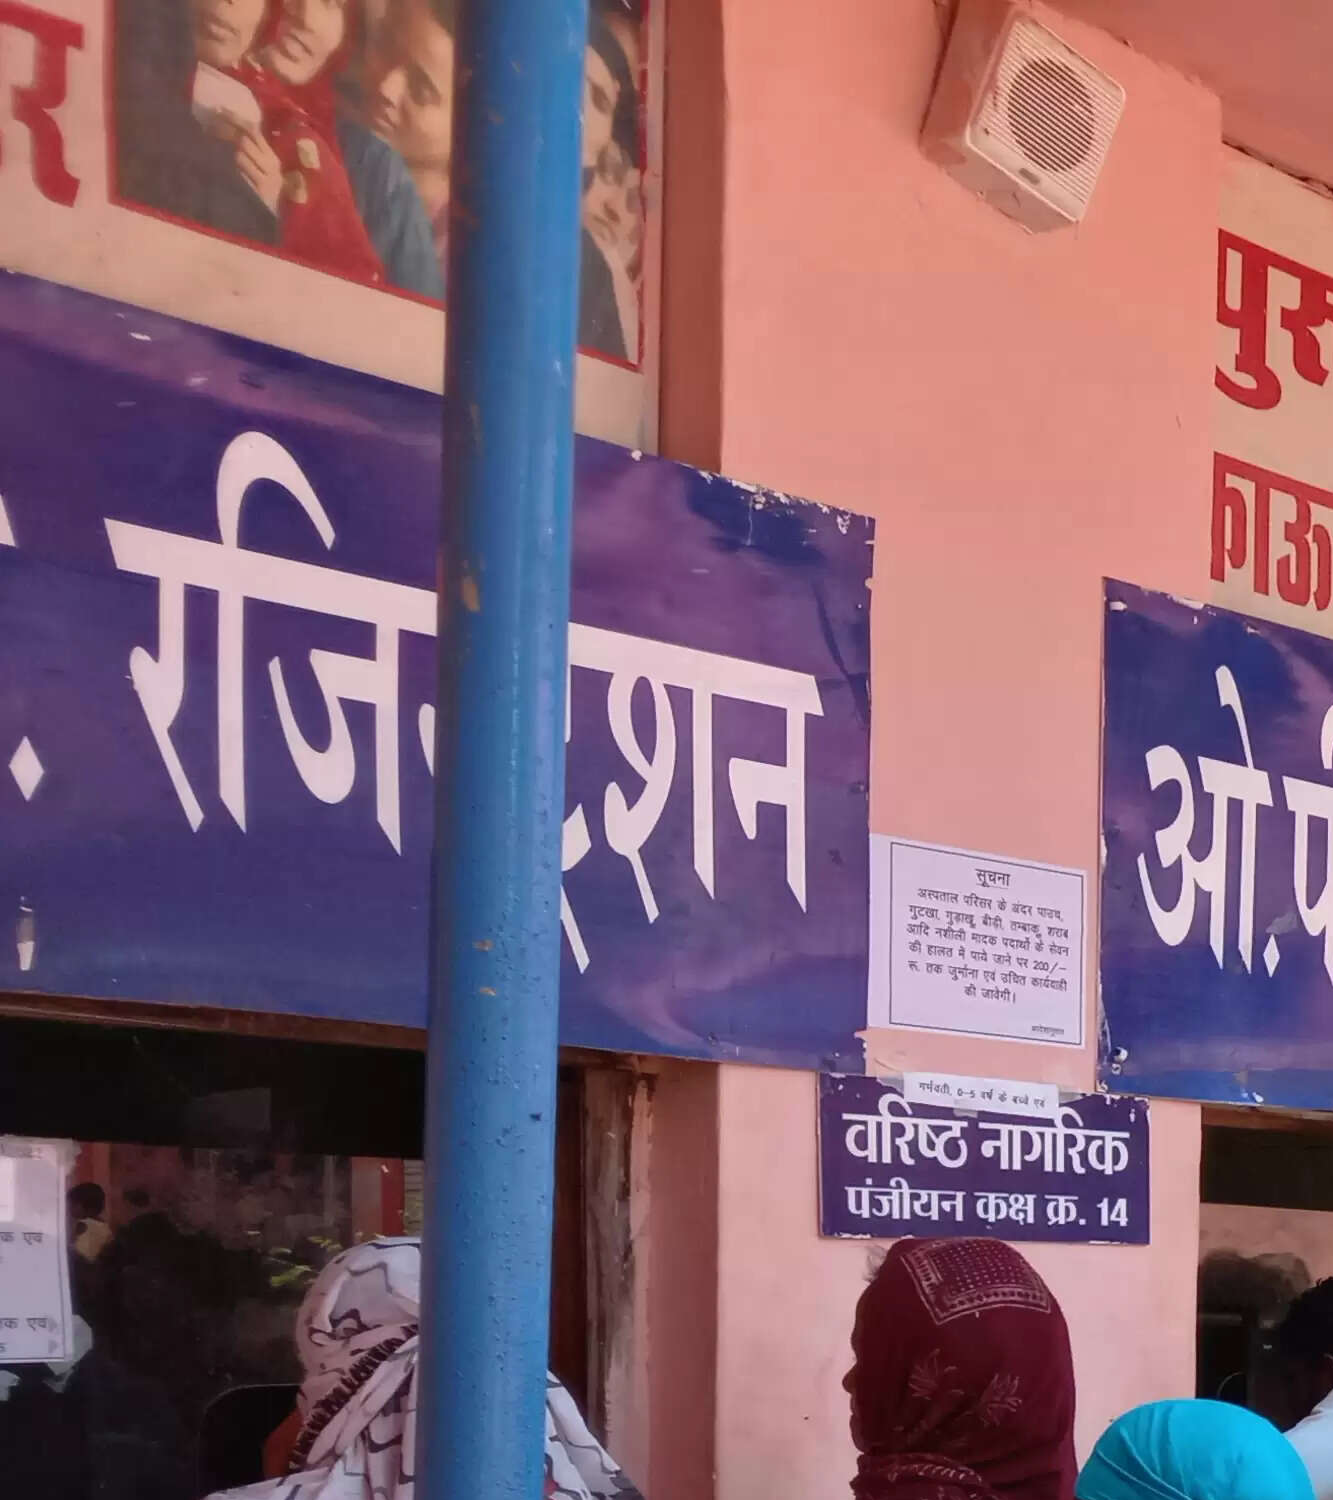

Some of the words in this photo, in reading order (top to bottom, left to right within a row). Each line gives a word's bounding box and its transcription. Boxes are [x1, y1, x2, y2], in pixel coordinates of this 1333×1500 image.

[975, 868, 1011, 887] सूचना
[917, 888, 958, 904] अस्पताल
[963, 892, 992, 911] परिसर
[998, 898, 1007, 911] के
[906, 922, 930, 937] आदि
[935, 925, 966, 942] नशीली
[971, 932, 998, 947] मादक
[1034, 940, 1045, 953] के
[909, 940, 922, 953] की
[927, 944, 953, 958] हालत
[993, 953, 1012, 967] जाने
[1016, 958, 1029, 970] पर
[926, 962, 943, 974] तक
[1001, 970, 1026, 986] उचित
[1031, 975, 1068, 992] कार्यवाही
[964, 984, 977, 997] की
[842, 1094, 968, 1169] वरिष्ठ
[979, 1107, 1130, 1175] नागरिक
[845, 1177, 967, 1222] पंजीयन
[974, 1191, 1036, 1223] कक्ष
[1047, 1194, 1087, 1226] क्र.
[1097, 1198, 1129, 1227] 14
